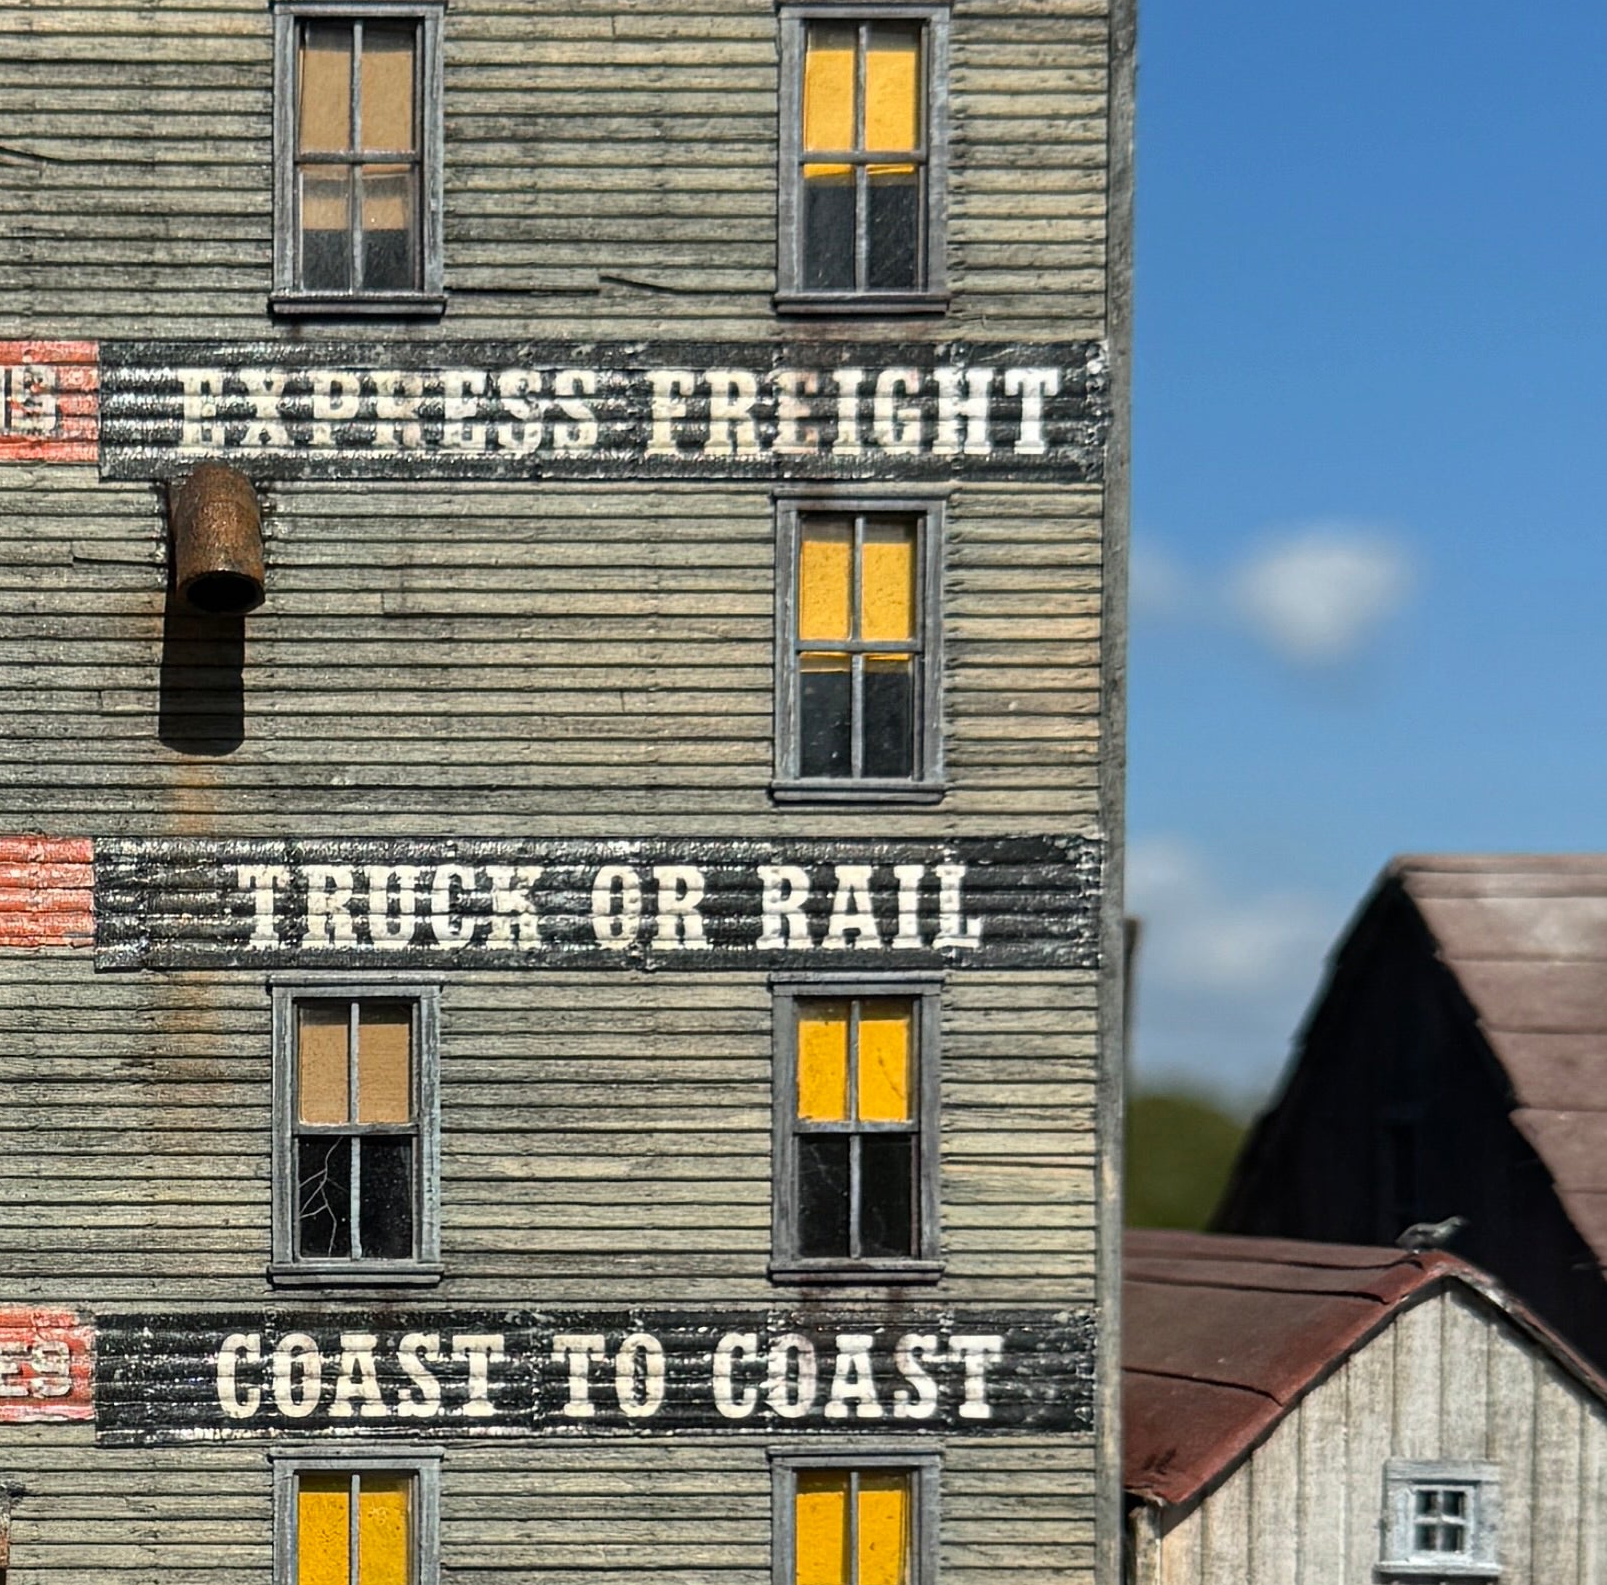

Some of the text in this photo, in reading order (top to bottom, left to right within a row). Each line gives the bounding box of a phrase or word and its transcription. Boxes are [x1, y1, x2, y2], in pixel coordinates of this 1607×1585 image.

[175, 366, 1064, 456] EXPRESS FREIGHT
[237, 863, 985, 952] TRUCK OR RAIL
[214, 1332, 1004, 1420] COAST TO COAST
